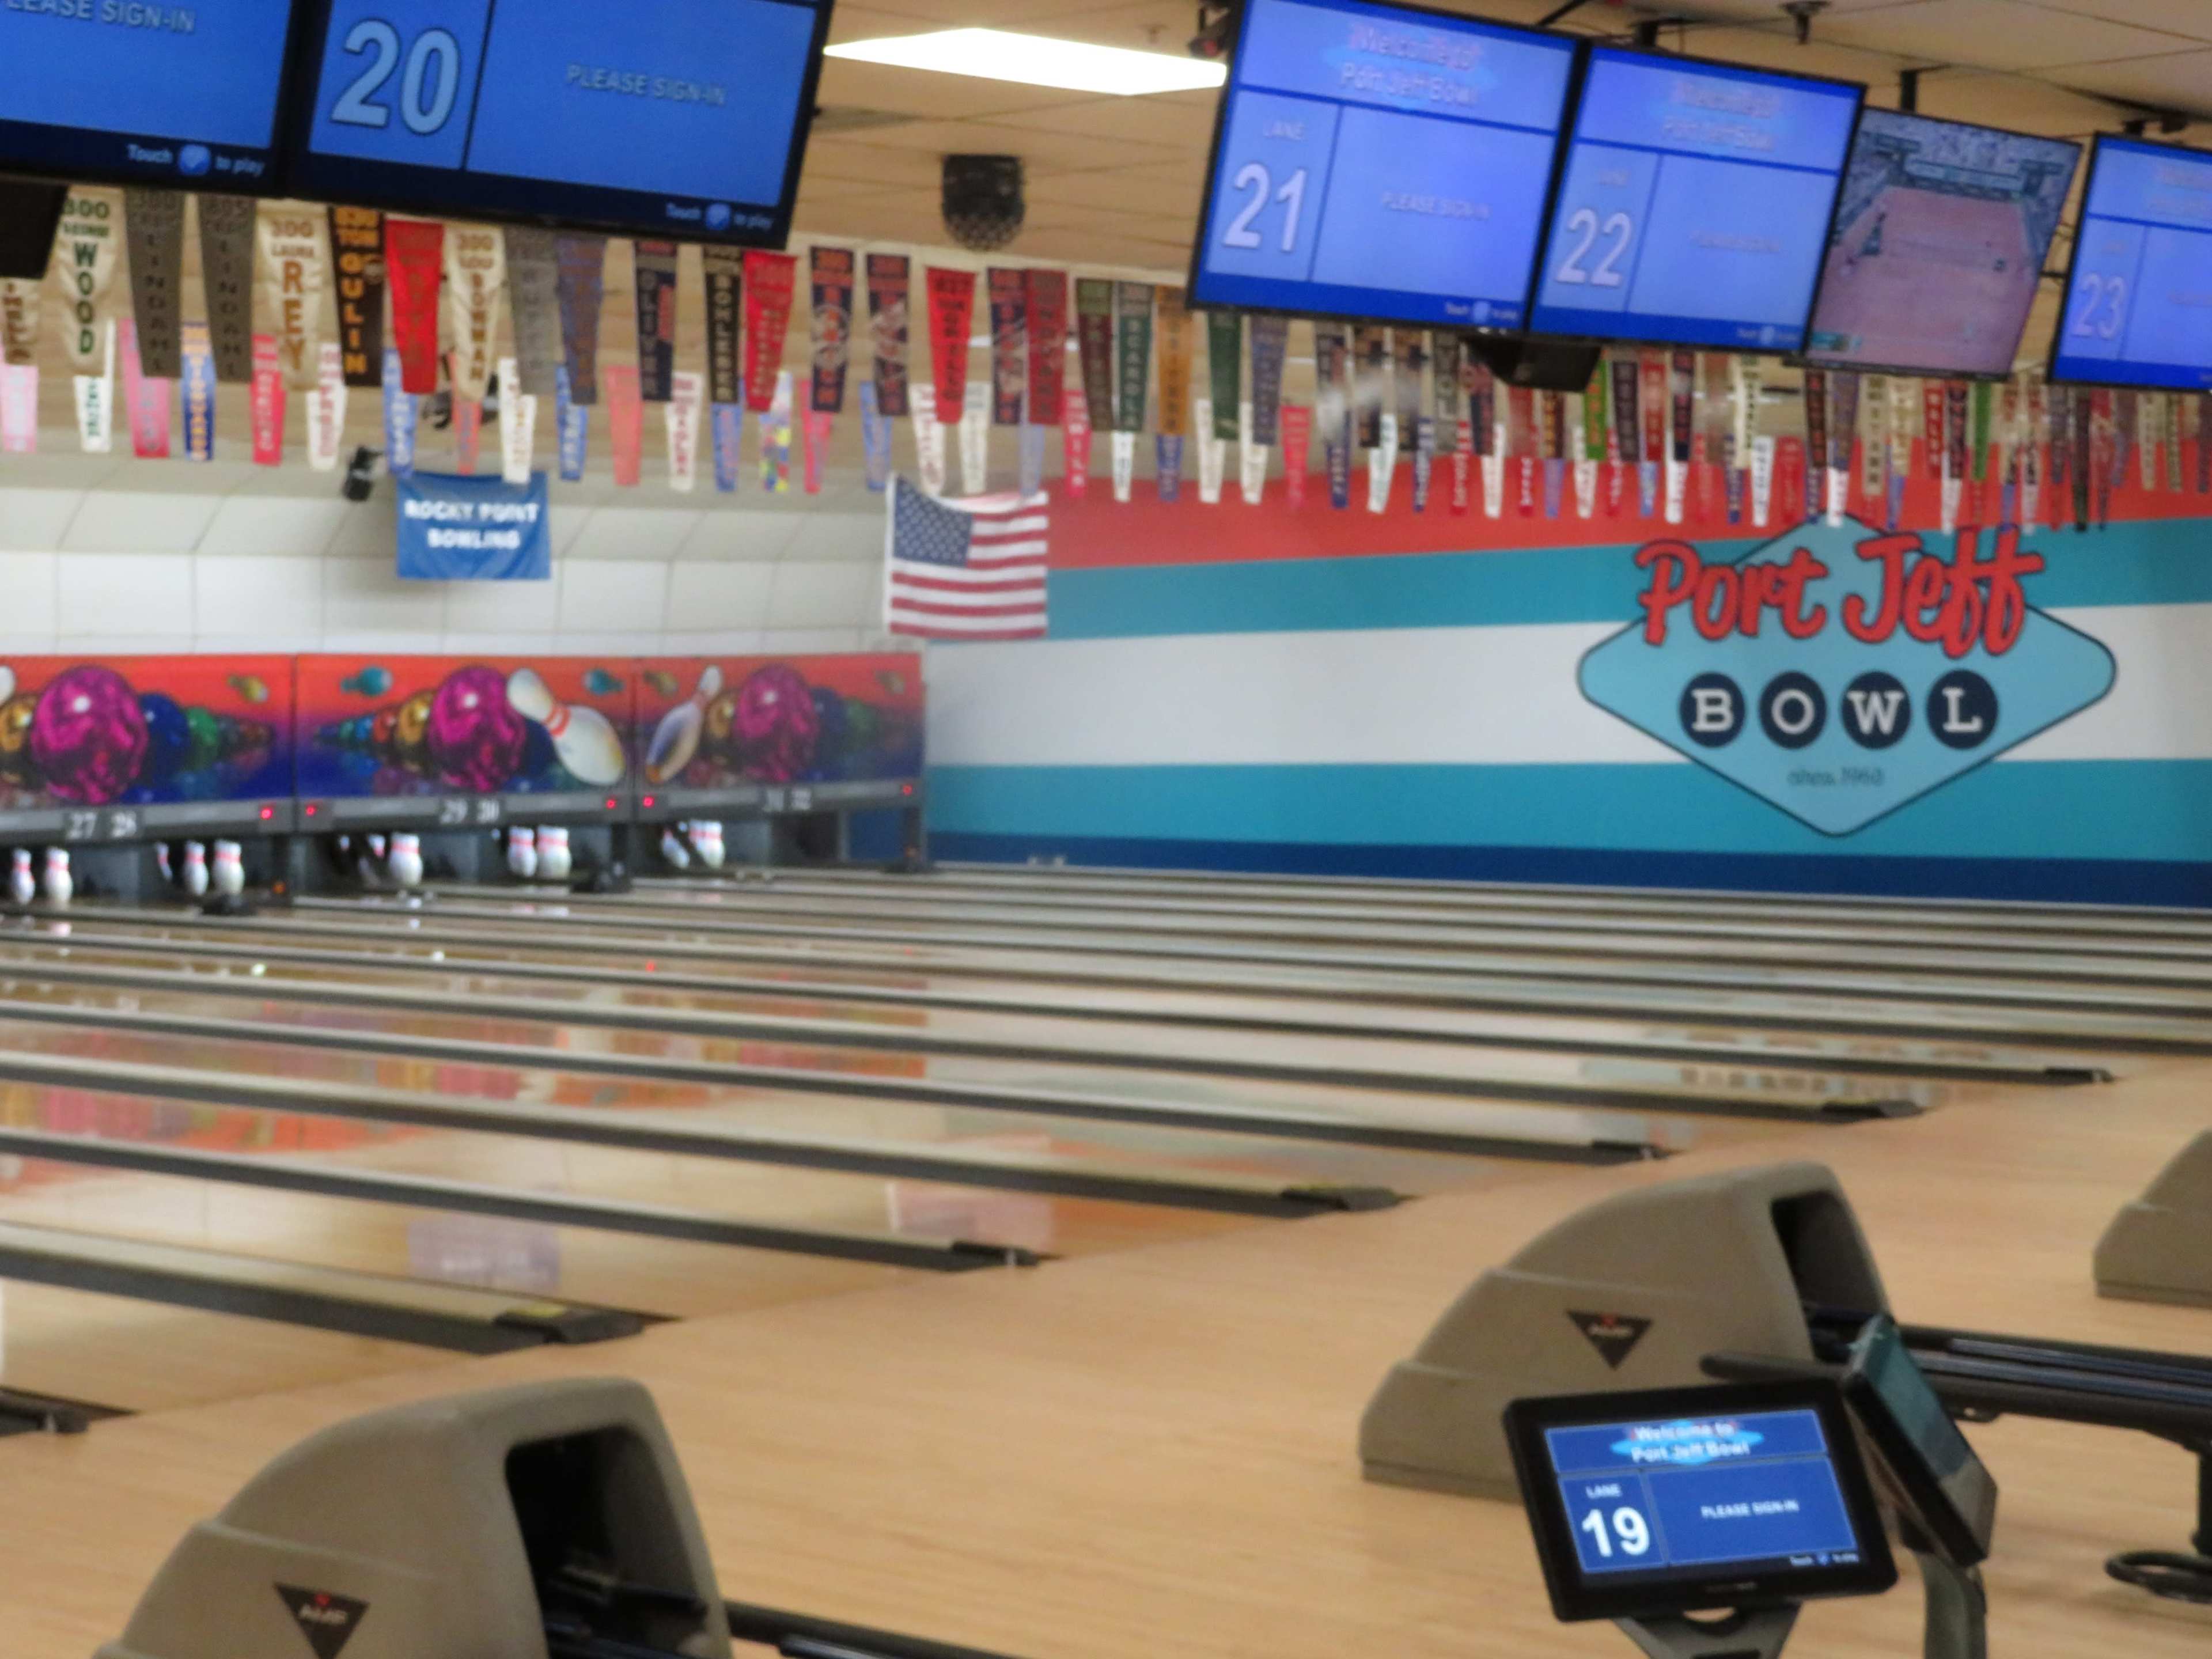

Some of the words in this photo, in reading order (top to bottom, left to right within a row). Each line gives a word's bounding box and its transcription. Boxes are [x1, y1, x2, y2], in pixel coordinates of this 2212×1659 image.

[101, 2, 195, 33] SIGN-IN
[330, 17, 460, 136] 20
[565, 63, 647, 97] PLEASE
[127, 143, 173, 164] Touch
[215, 157, 230, 171] to
[233, 158, 266, 177] play
[1222, 162, 1308, 253] 21
[1555, 208, 1633, 287] 22
[73, 243, 98, 356] WOOD
[283, 260, 306, 370] REY
[2070, 272, 2126, 340] 23
[404, 499, 474, 522] ROCKY
[427, 527, 521, 550] BOWLING
[1634, 538, 1830, 646] Port
[1842, 525, 2046, 658] Jeff
[1691, 687, 1983, 735] BOWL
[1631, 1444, 1670, 1463] Port
[1586, 1483, 1622, 1499] LANE
[1700, 1502, 1751, 1519] PLEASE
[1751, 1499, 1801, 1516] SIGN-IN
[1581, 1506, 1651, 1558] 19
